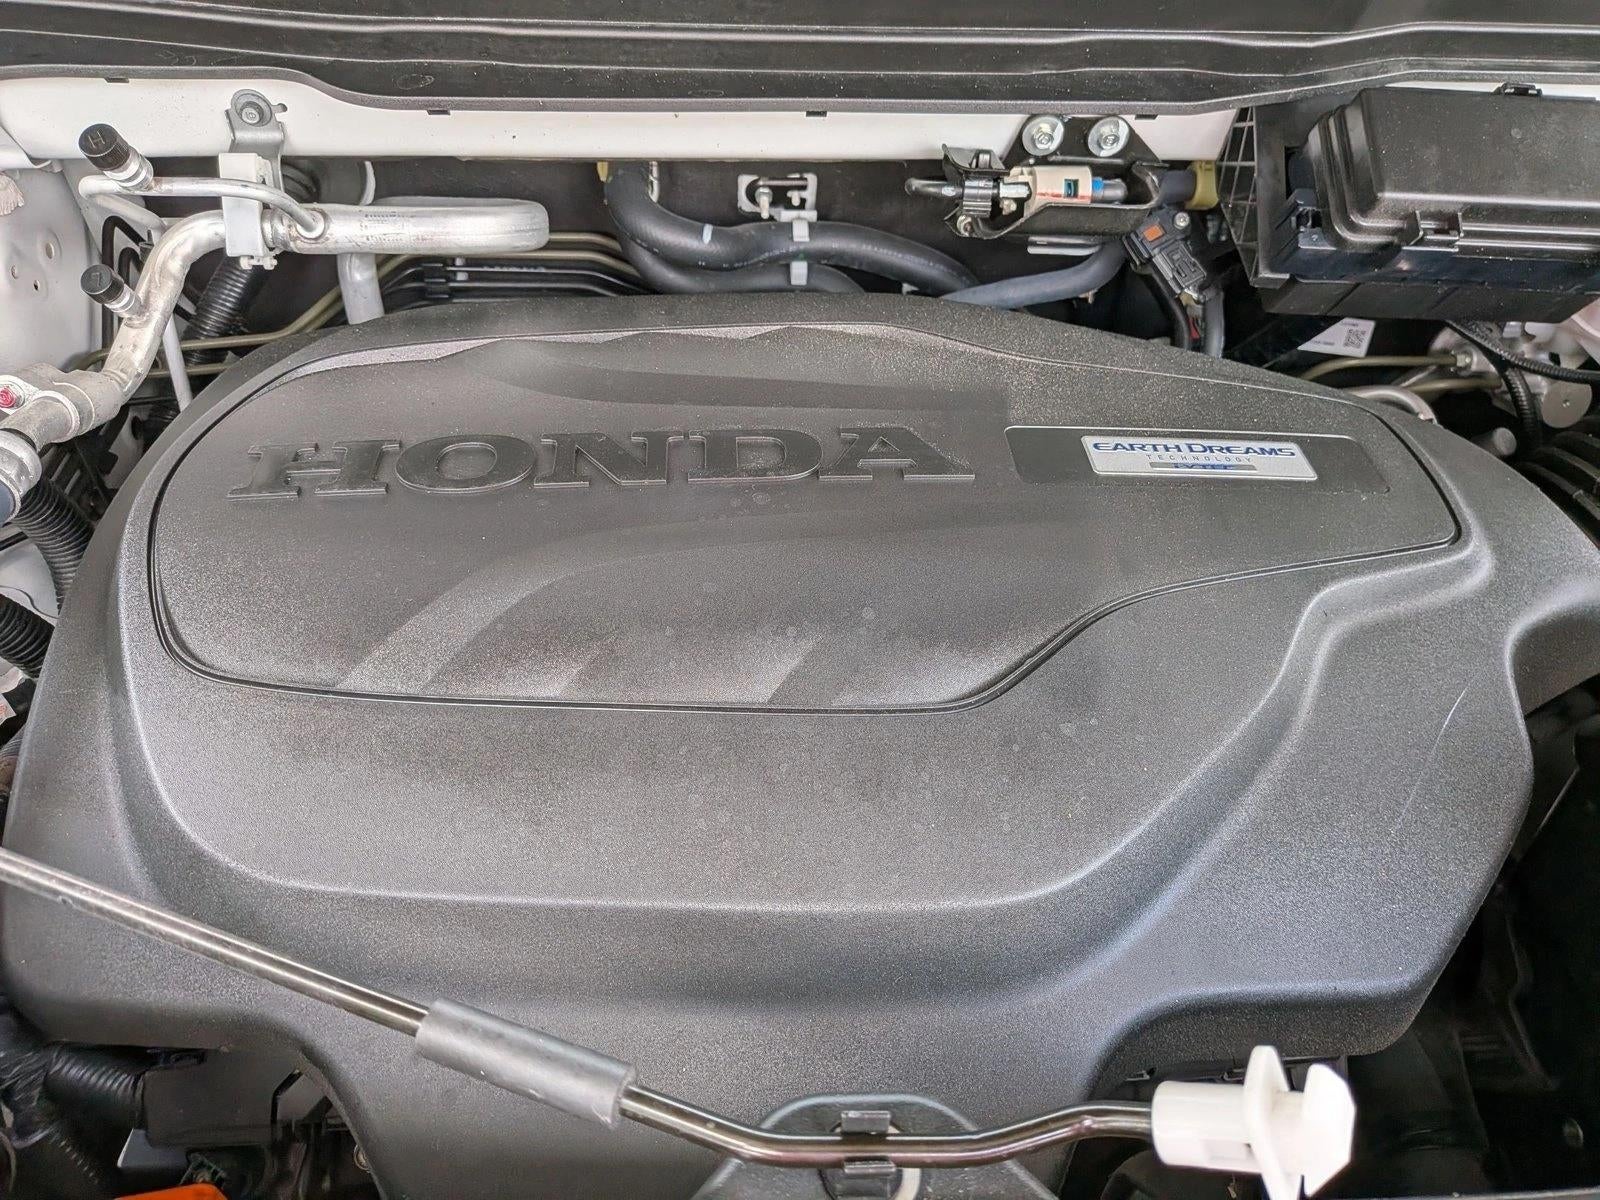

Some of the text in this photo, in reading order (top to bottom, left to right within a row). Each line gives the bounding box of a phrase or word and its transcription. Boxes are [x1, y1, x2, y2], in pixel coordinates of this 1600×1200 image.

[1092, 441, 1296, 457] EARTH DREAMS
[227, 425, 976, 499] HONDA
[1145, 453, 1252, 463] TECHNOLOGY
